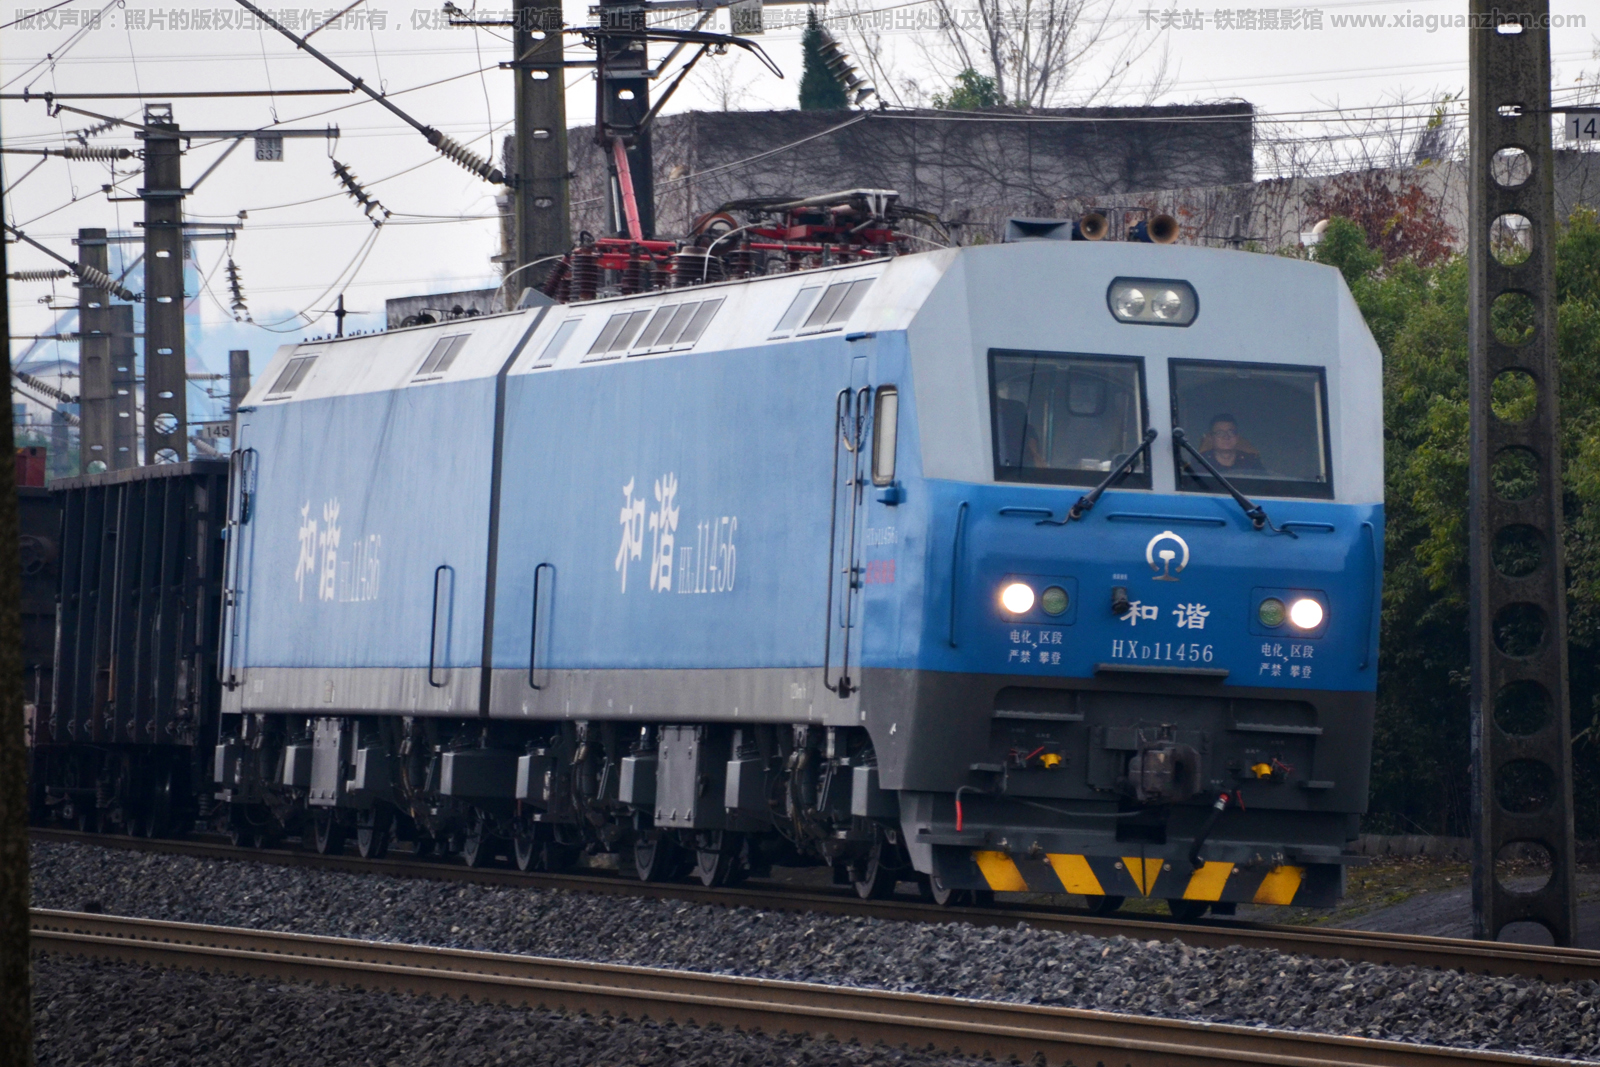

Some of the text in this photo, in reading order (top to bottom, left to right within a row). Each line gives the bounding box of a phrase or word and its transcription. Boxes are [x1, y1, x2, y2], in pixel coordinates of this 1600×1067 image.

[206, 425, 230, 438] 145
[615, 471, 680, 594] 和谐
[295, 496, 341, 602] 和谐
[1120, 600, 1211, 630] 和谐
[1111, 639, 1214, 663] HXD11456
